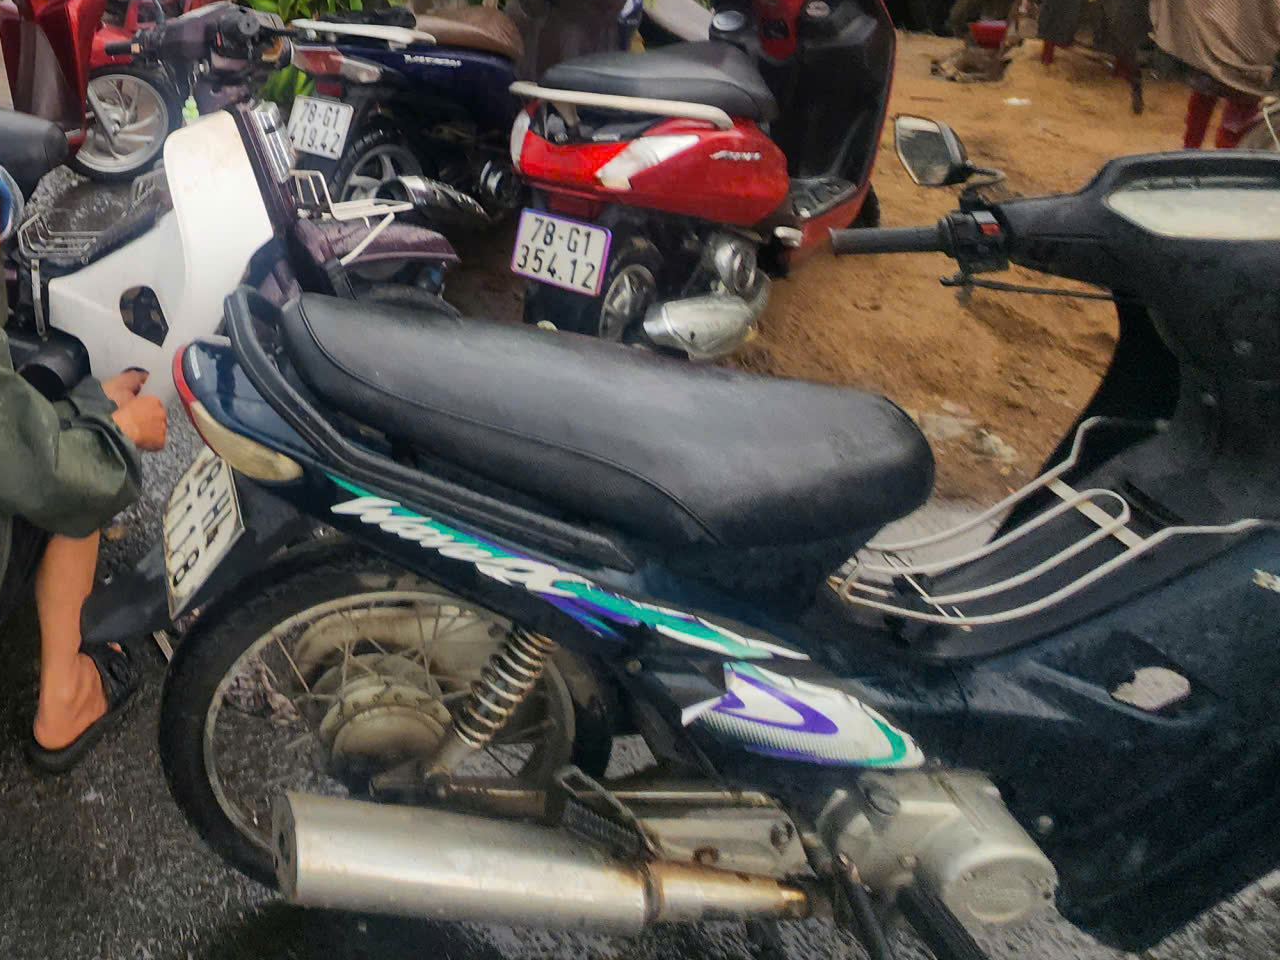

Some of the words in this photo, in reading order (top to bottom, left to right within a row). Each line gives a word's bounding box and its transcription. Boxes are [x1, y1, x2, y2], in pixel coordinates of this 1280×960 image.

[300, 102, 340, 128] 78-G1
[530, 216, 592, 257] 78-G1
[516, 244, 596, 290] 354.12
